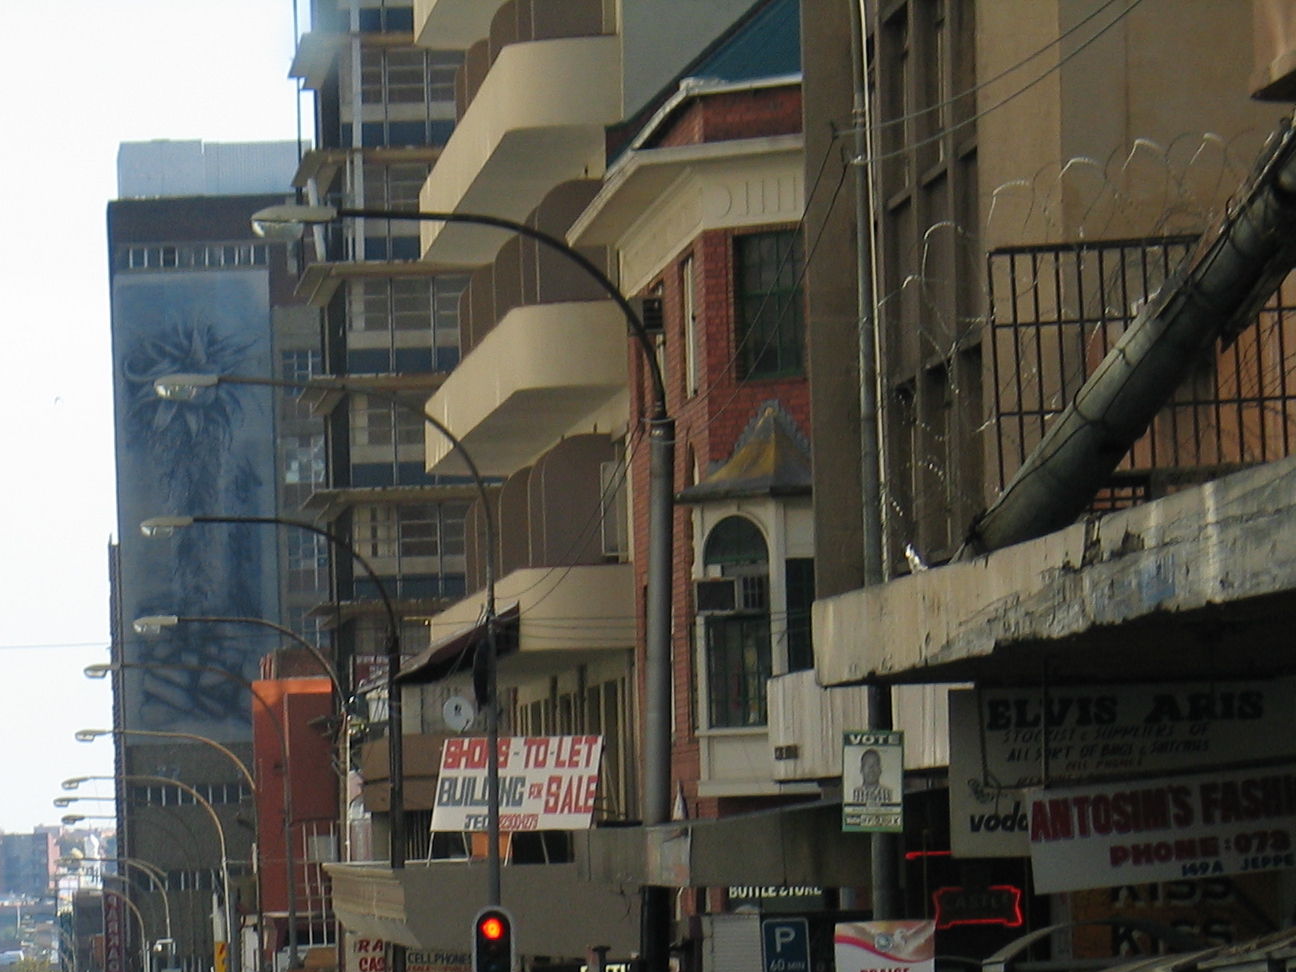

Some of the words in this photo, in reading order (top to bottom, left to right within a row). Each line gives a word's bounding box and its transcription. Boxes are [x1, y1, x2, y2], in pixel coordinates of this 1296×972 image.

[987, 695, 1118, 730] ELVIS
[1144, 690, 1264, 724] ARIS
[443, 738, 511, 769] SHOS
[848, 733, 901, 745] VOTE
[544, 775, 598, 814] SALE
[1031, 784, 1194, 842] ANTOSIM'S
[774, 926, 796, 953] P
